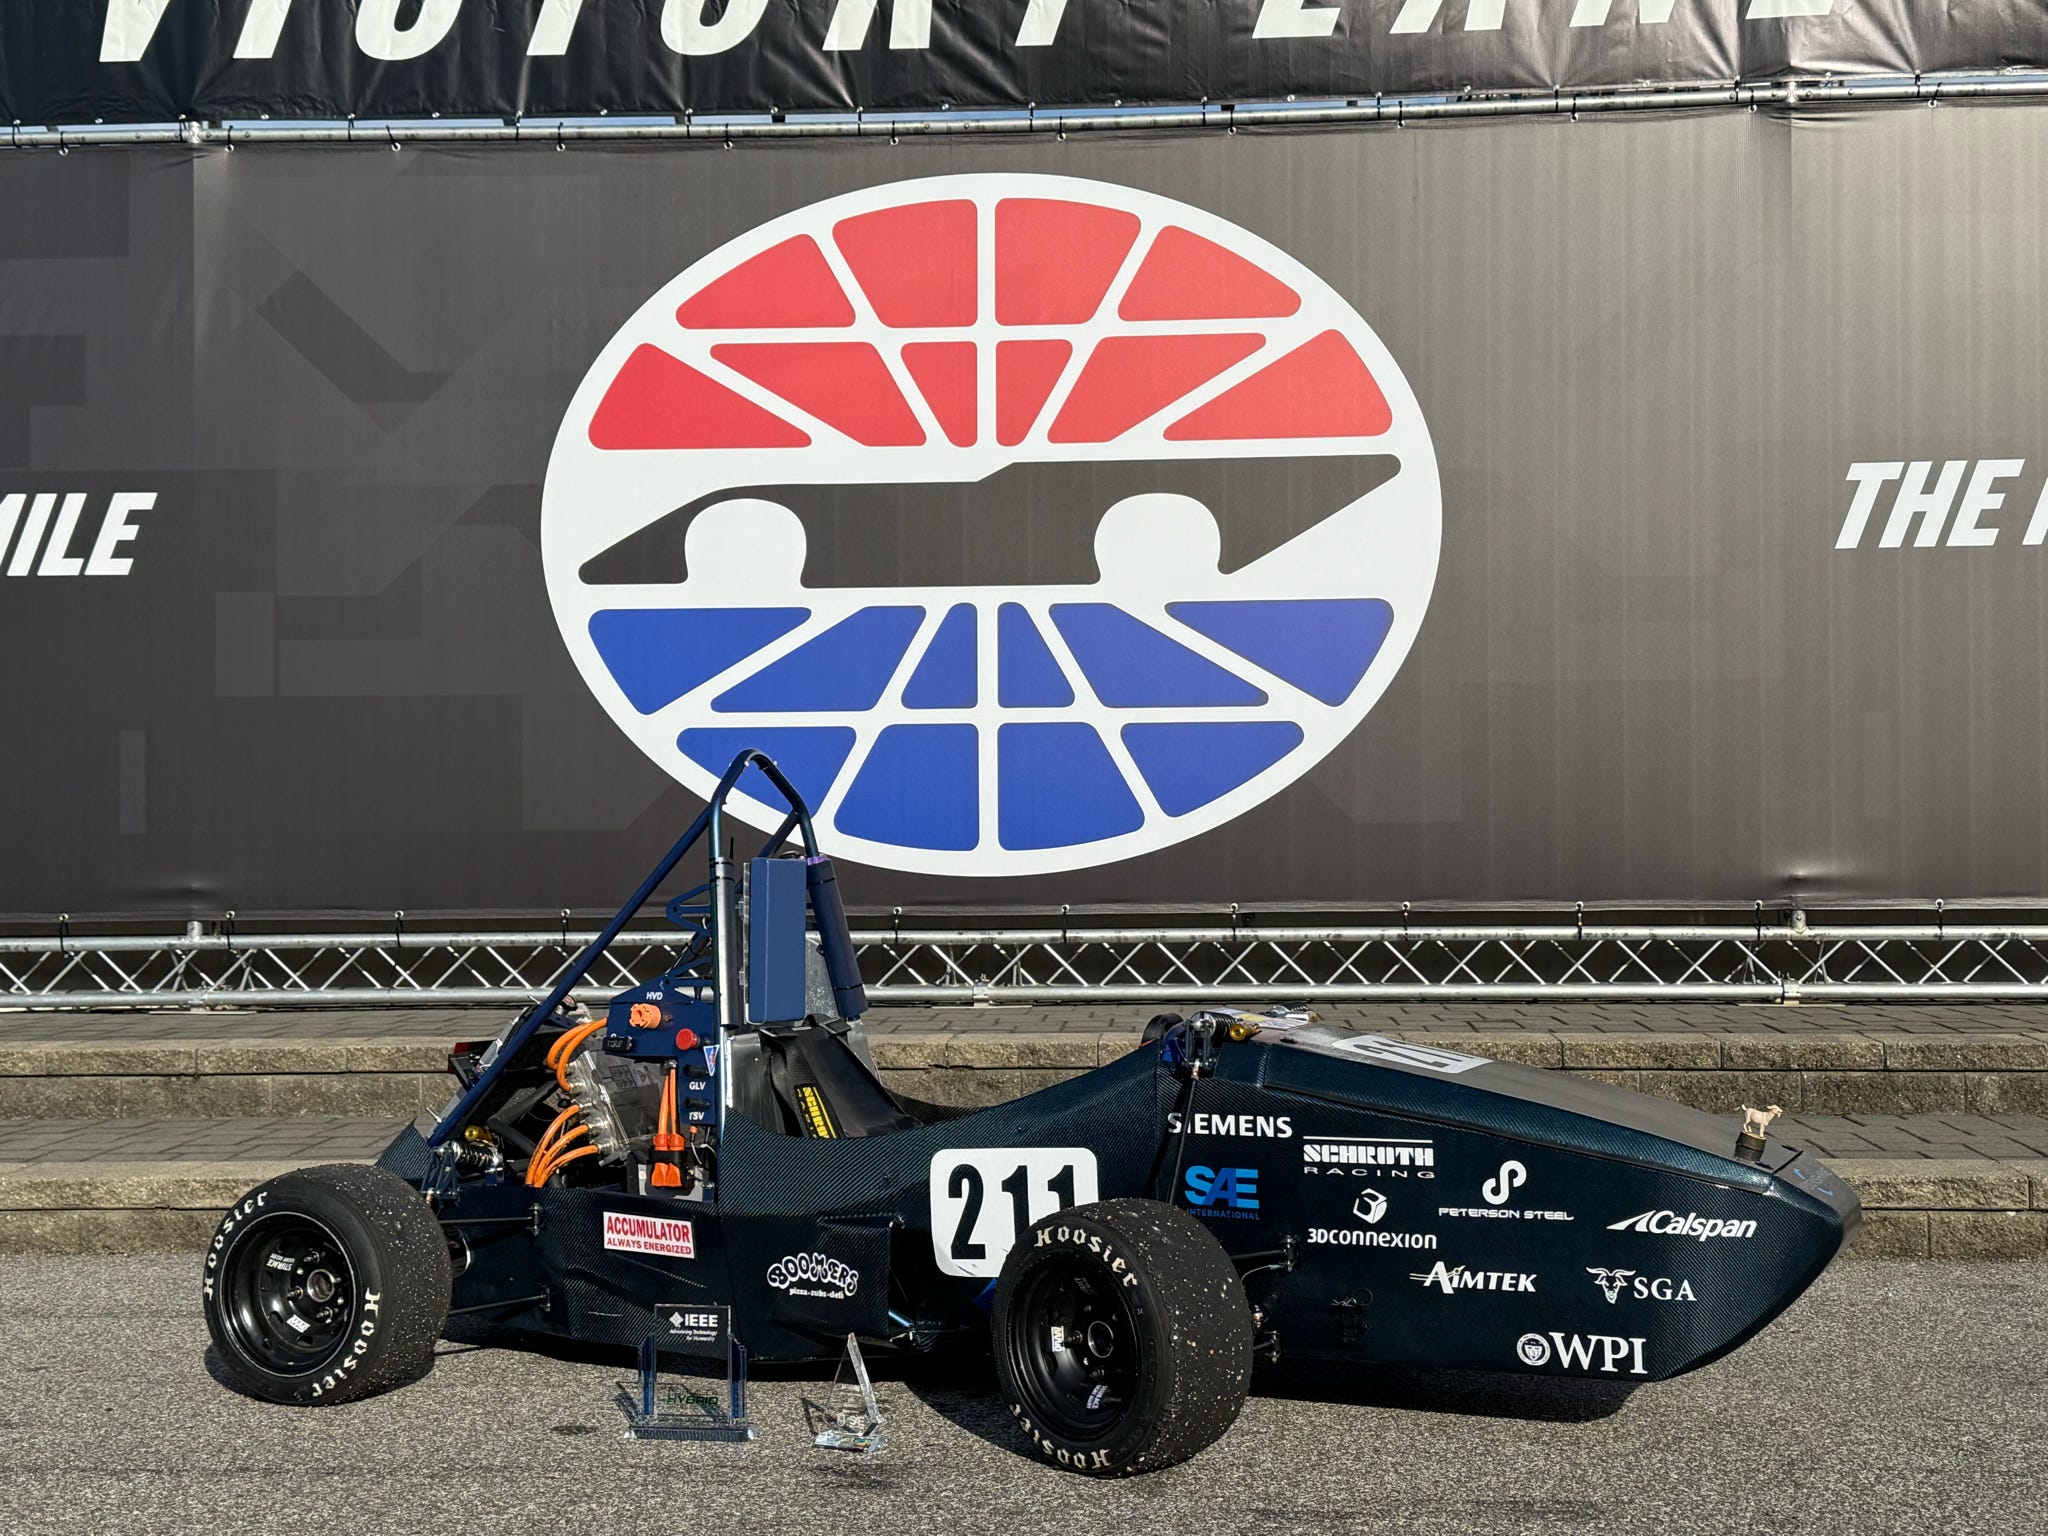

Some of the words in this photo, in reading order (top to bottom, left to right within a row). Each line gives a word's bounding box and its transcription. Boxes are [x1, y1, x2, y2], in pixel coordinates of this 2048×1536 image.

[1834, 458, 2026, 549] THE
[646, 991, 663, 1000] HVD
[689, 1081, 706, 1090] GLV
[1303, 1144, 1434, 1166] SCHROTH
[1304, 1166, 1435, 1179] RACING
[1185, 1165, 1260, 1209] SAE
[1438, 1207, 1520, 1219] PETERSON
[1524, 1210, 1575, 1221] STEEL
[1649, 1210, 1757, 1241] Calspan
[606, 1215, 690, 1243] ACCUMULATOR
[606, 1237, 642, 1249] ALWAYS
[643, 1241, 692, 1255] ENERGIZED
[1034, 1225, 1138, 1288] Hoosier
[766, 1252, 859, 1297] BOOMERS
[1633, 1276, 1697, 1301] SGA
[684, 1313, 719, 1328] IEEE
[311, 1287, 381, 1397] Hoosier
[1548, 1332, 1648, 1374] WPI
[667, 1395, 719, 1405] HYBRID
